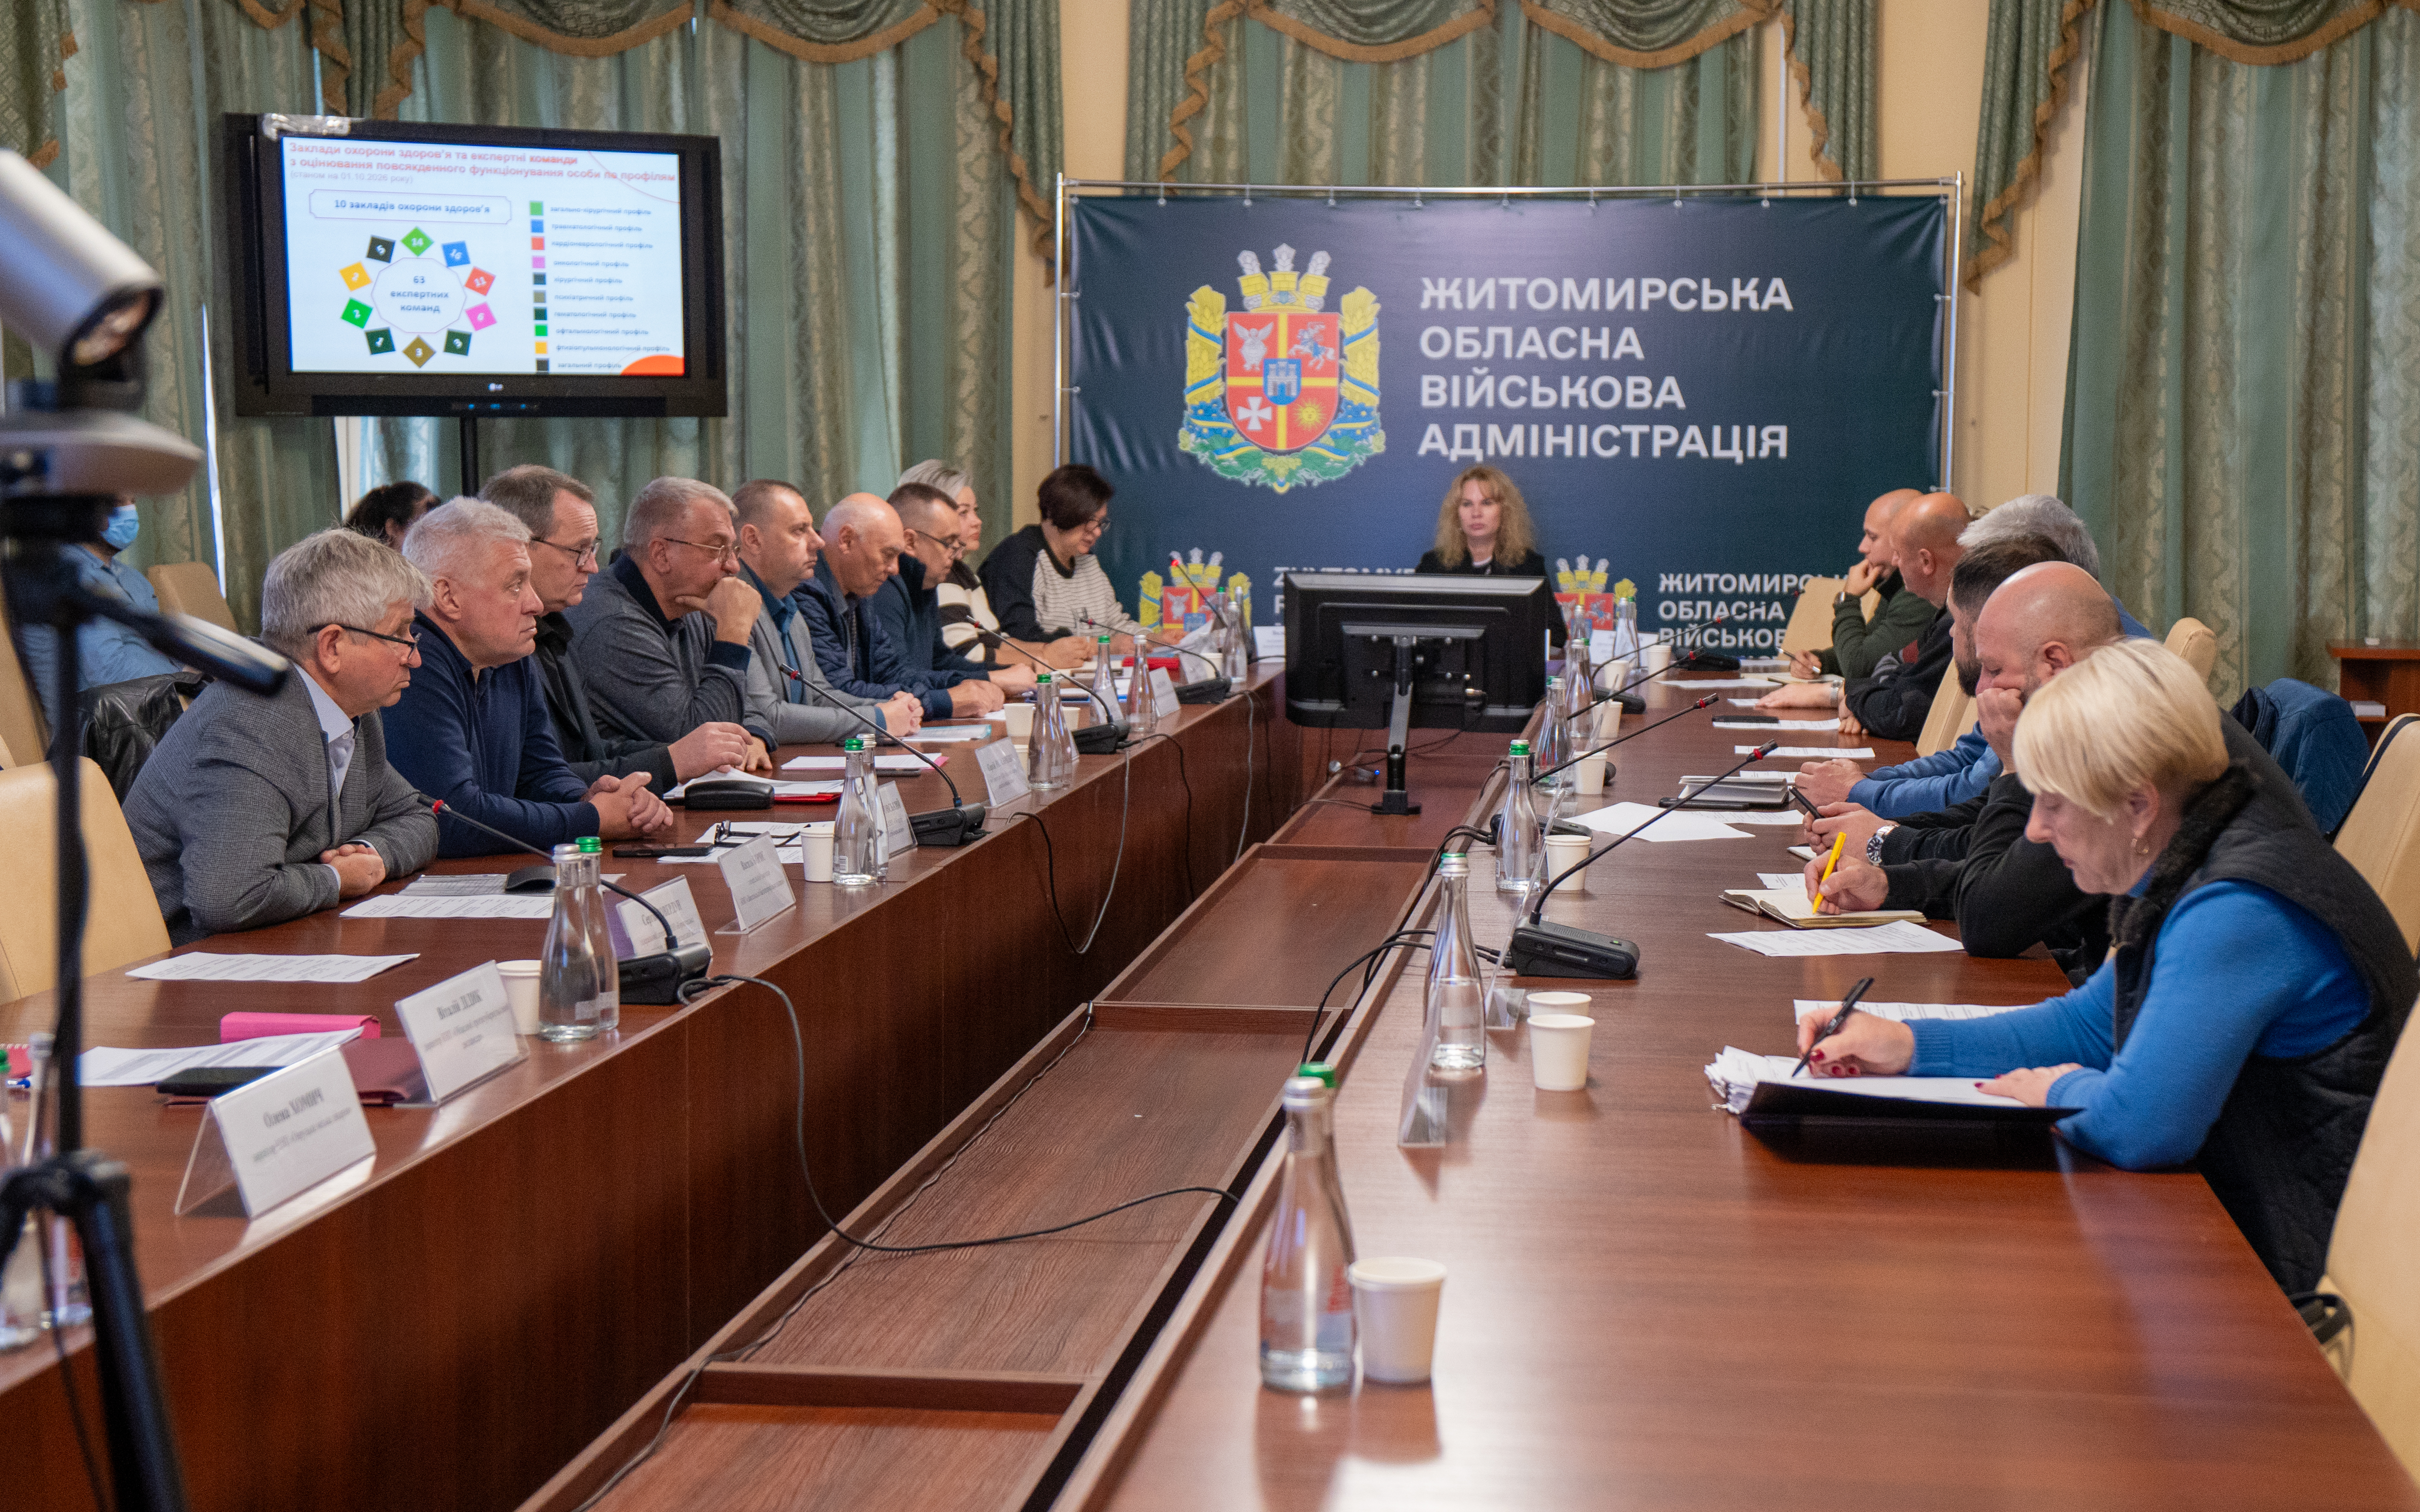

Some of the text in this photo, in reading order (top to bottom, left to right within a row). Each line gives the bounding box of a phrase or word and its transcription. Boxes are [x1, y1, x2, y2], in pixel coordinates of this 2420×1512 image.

[289, 143, 340, 155] Заклади
[345, 147, 395, 157] охорони
[471, 153, 525, 163] експертні
[530, 156, 578, 165] команди
[300, 158, 372, 169] оцінювання
[376, 163, 465, 173] повсякденного
[469, 165, 563, 177] функціонування
[568, 169, 600, 178] особи
[621, 172, 675, 182] профілям
[335, 200, 346, 209] 10
[349, 201, 395, 212] закладів
[398, 204, 441, 213] охорони
[412, 238, 424, 247] 14
[376, 245, 386, 255] 5
[450, 249, 462, 260] 16
[413, 275, 425, 284] 63
[474, 276, 486, 287] 11
[390, 291, 449, 299] експертних
[1420, 277, 1794, 311] ЖИТОМИРСЬКА
[353, 309, 361, 318] 2
[400, 305, 440, 314] команд
[1420, 326, 1645, 360] ОБЛАСНА
[415, 348, 423, 358] 3
[1421, 367, 1686, 409] ВІЙСЬКОВА
[1418, 423, 1788, 464] АДМІНІСТРАЦІЯ
[1659, 600, 1785, 621] ОБЛАСНА
[1659, 623, 1787, 648] ВІЙСЬКОВ
